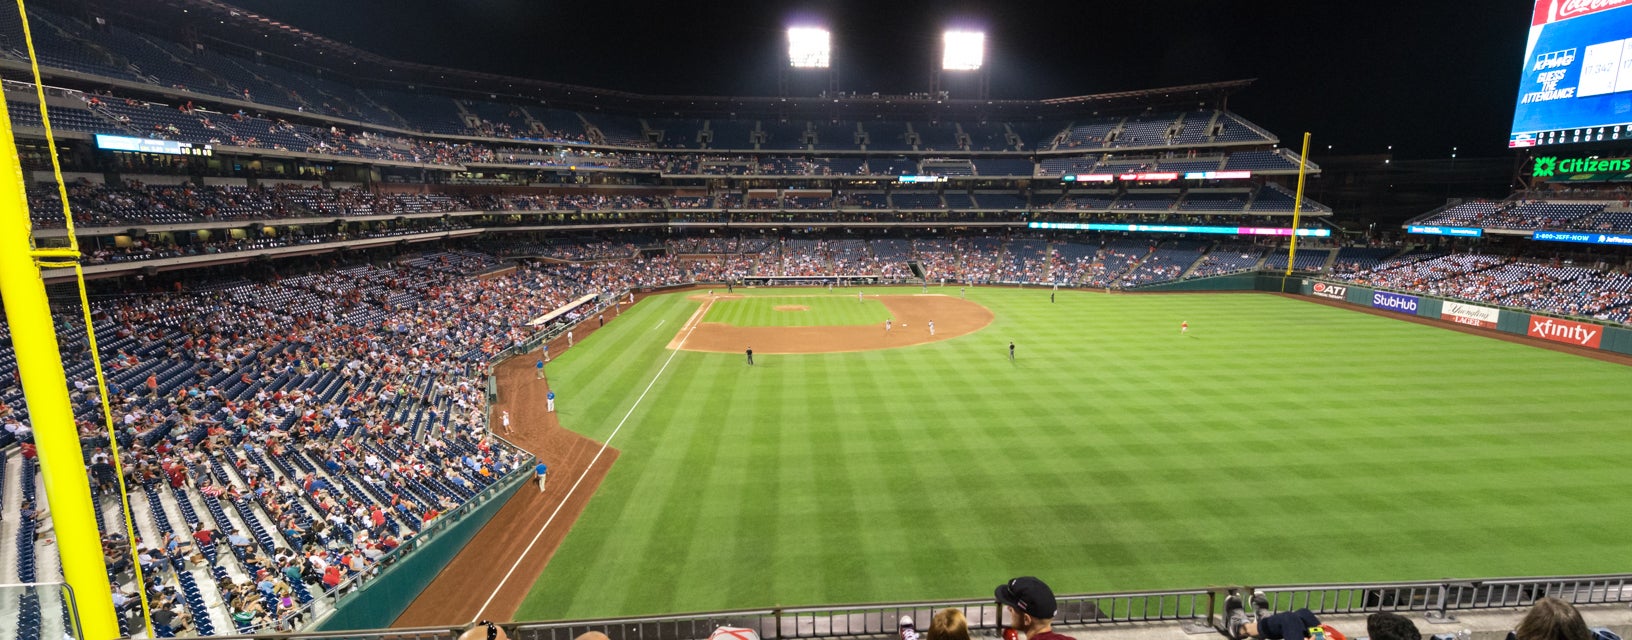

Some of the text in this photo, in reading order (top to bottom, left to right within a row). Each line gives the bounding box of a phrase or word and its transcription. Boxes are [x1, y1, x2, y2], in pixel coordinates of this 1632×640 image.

[1533, 54, 1575, 71] KPMG
[1536, 69, 1567, 83] GUESS
[1541, 80, 1558, 92] THE
[1521, 87, 1576, 104] ATTENDANCE
[1559, 158, 1631, 173] Citizens
[1535, 233, 1590, 242] 1-800-JEFF-NOW
[1324, 285, 1347, 296] ATI
[1373, 294, 1417, 311] StubHub
[1455, 315, 1480, 327] LAGER
[1532, 319, 1597, 345] xfinity
